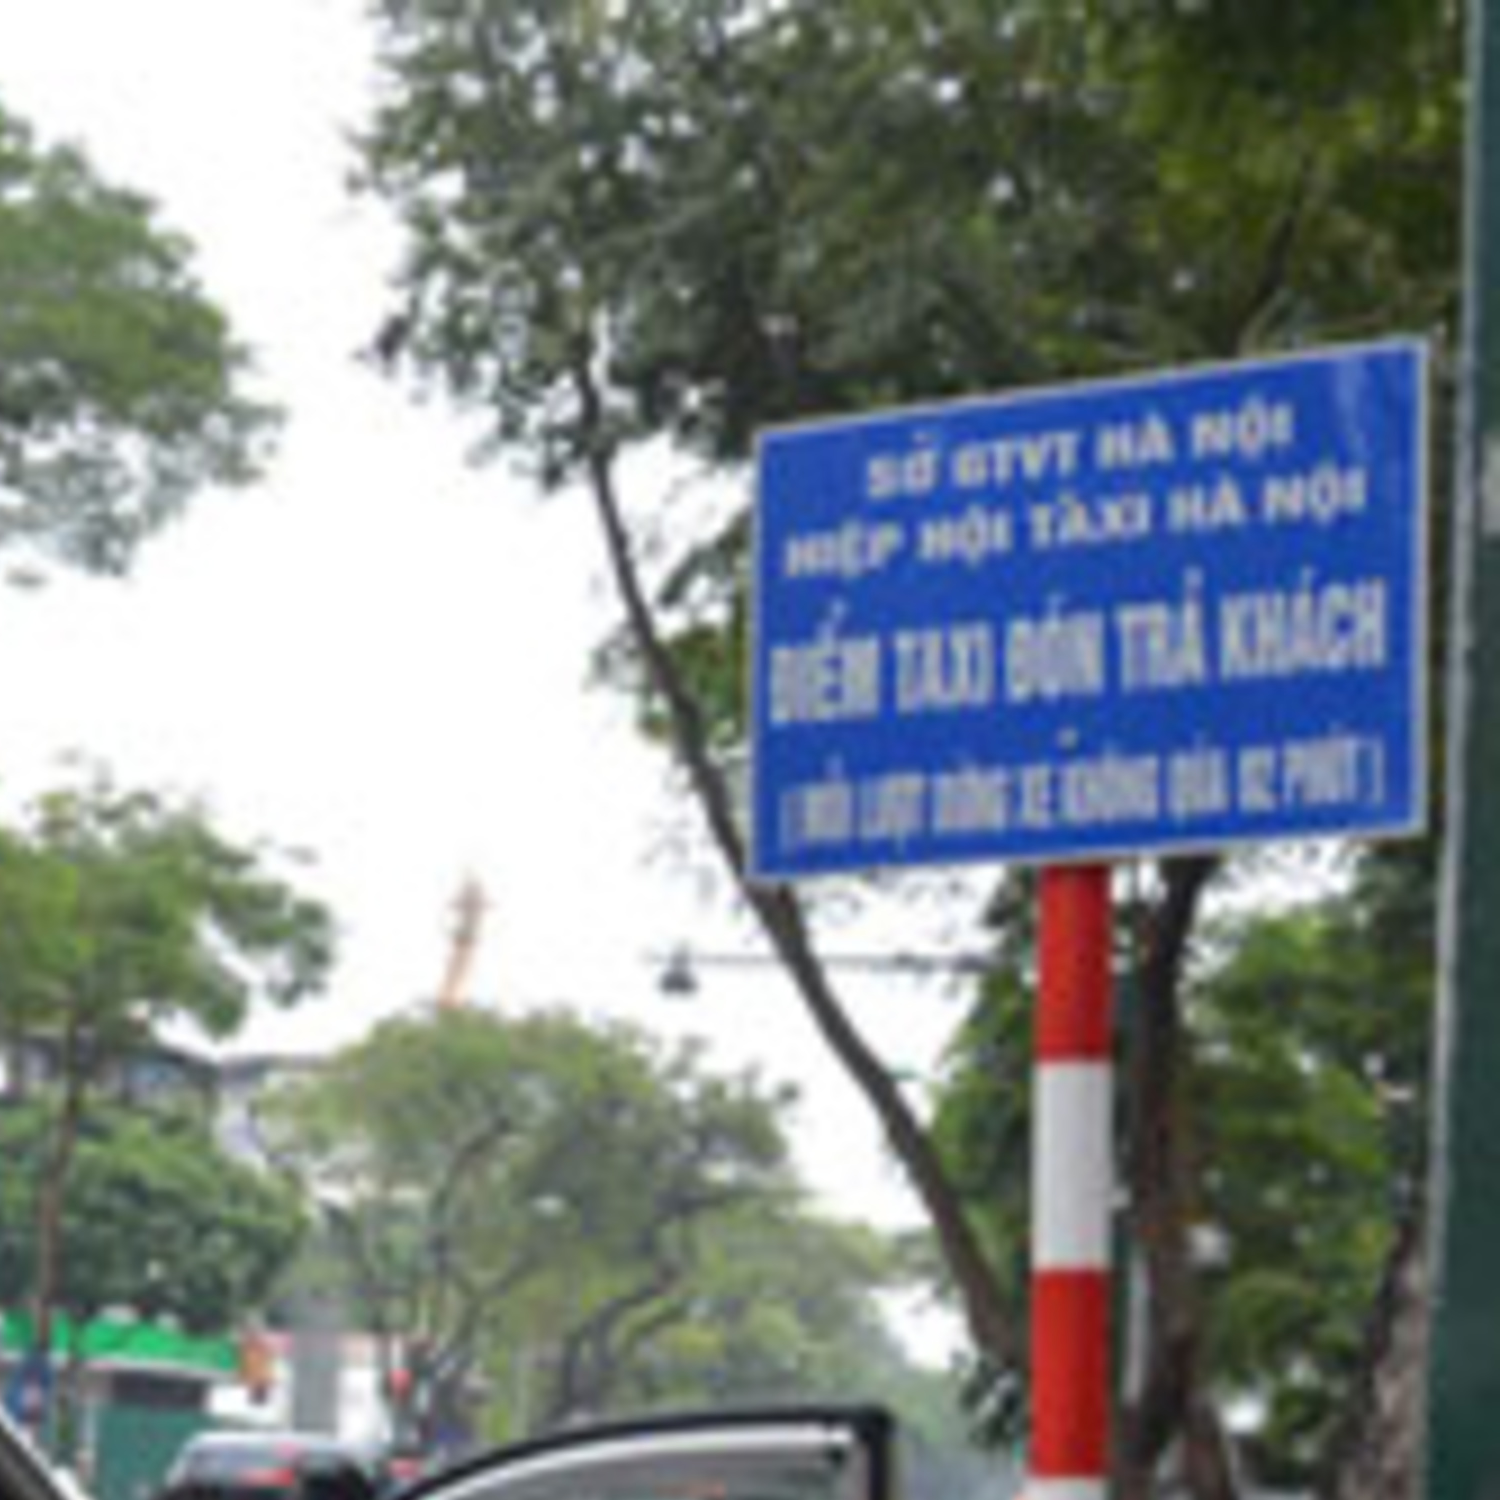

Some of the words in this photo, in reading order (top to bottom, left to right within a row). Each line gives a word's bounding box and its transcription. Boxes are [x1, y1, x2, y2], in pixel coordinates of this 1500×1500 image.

[867, 430, 935, 498] SỞ
[953, 430, 1080, 488] GTVT
[1099, 412, 1173, 466] HÀ
[1191, 395, 1294, 460] NỘI
[785, 519, 902, 577] HIỆP
[919, 511, 1011, 568] HỘI
[1169, 475, 1245, 530] HÀ
[1264, 462, 1366, 525] NỘI
[893, 620, 993, 713] TAXI
[1118, 568, 1207, 690] TRẢ
[1220, 566, 1385, 680] KHÁCH
